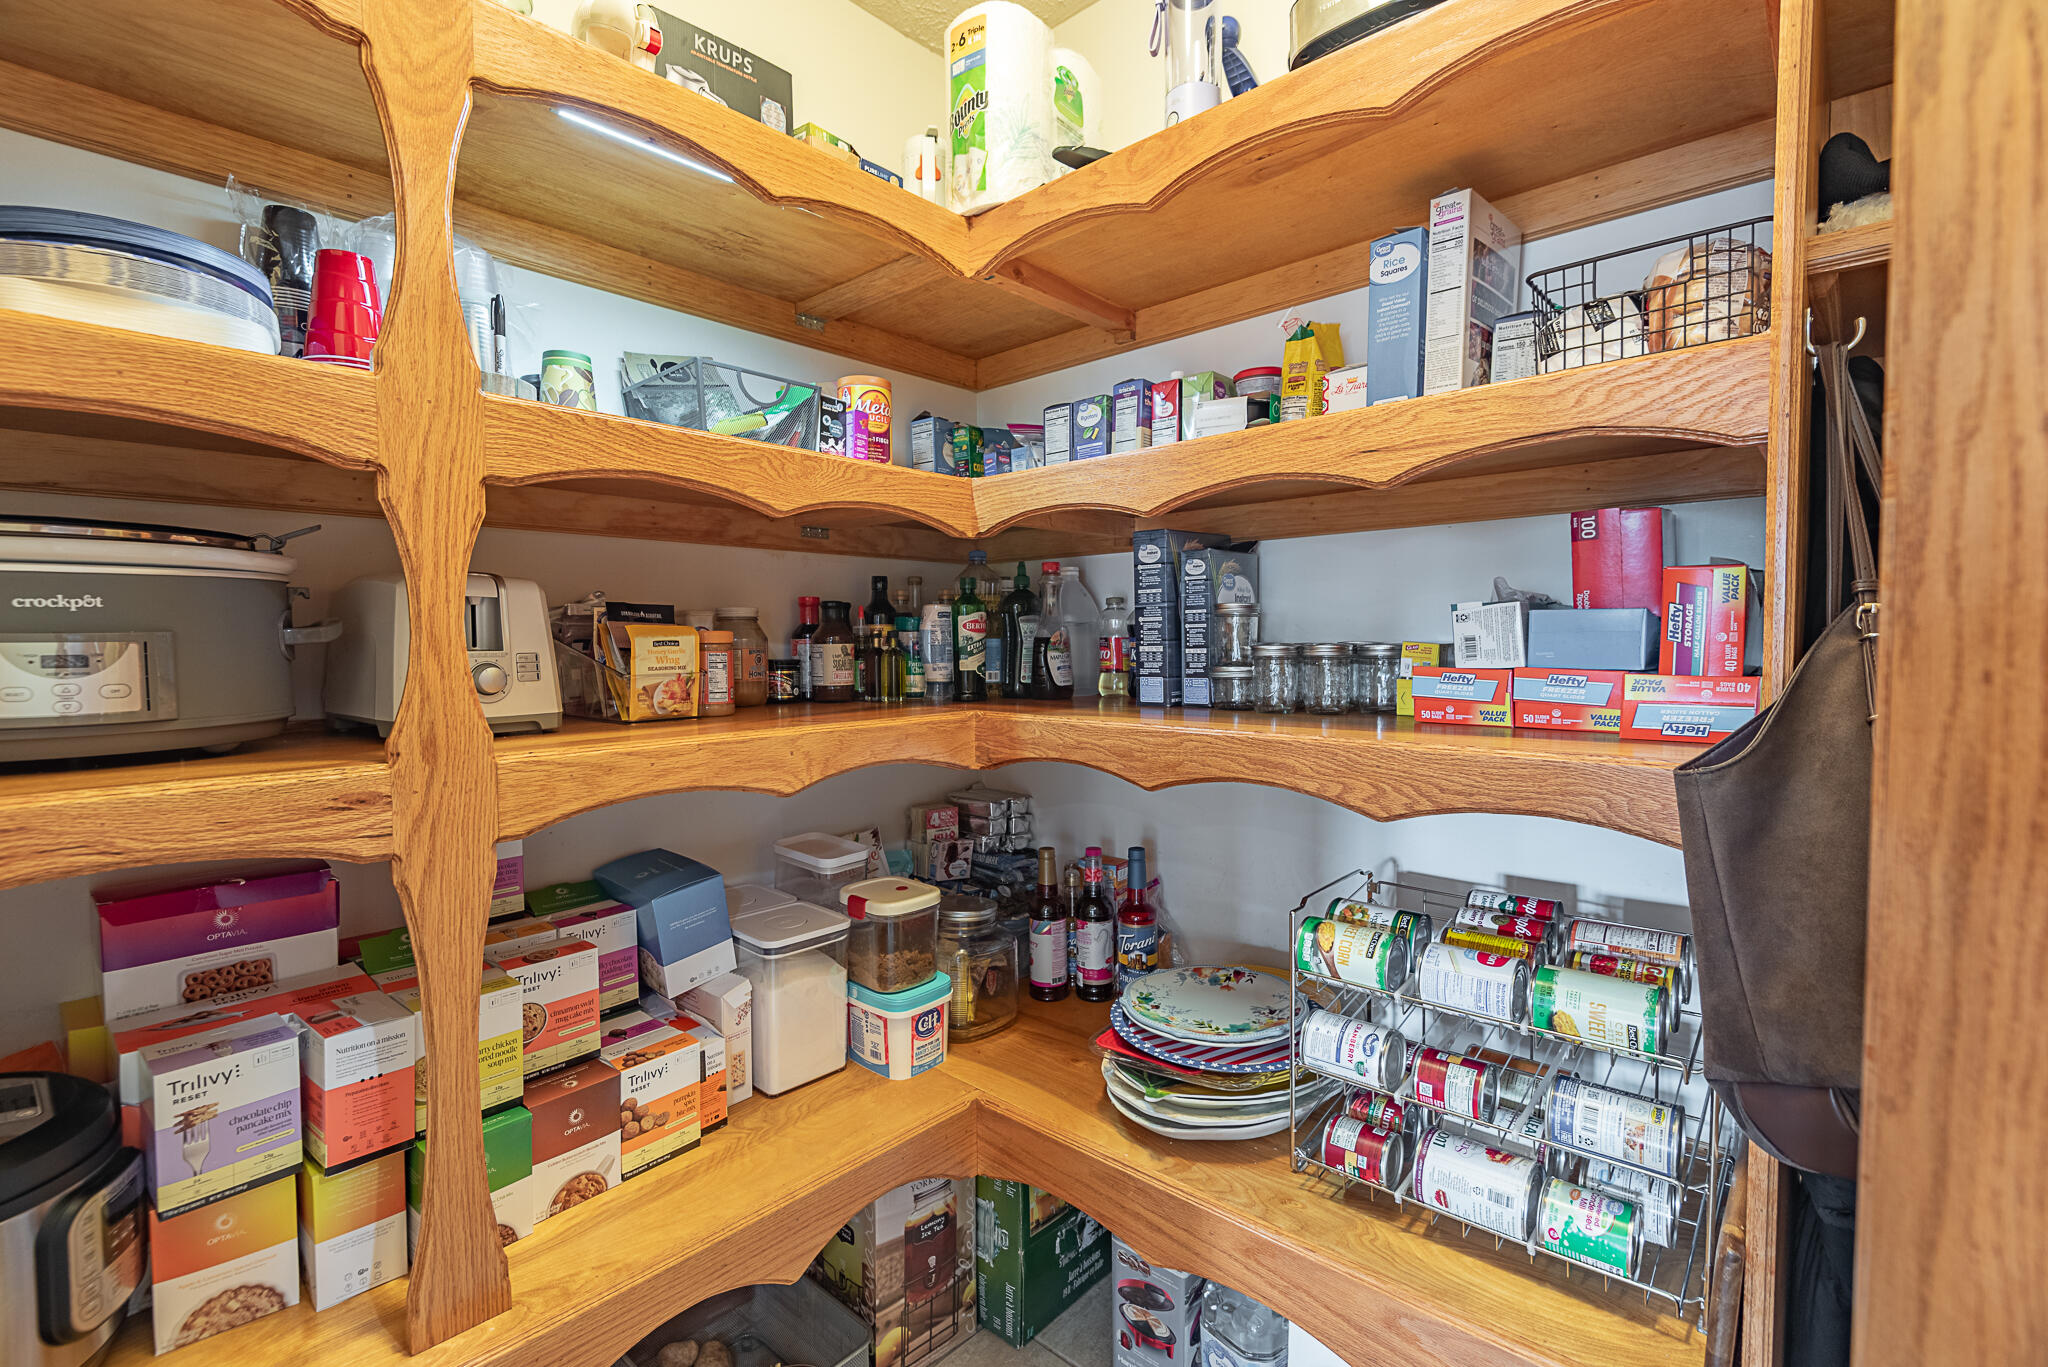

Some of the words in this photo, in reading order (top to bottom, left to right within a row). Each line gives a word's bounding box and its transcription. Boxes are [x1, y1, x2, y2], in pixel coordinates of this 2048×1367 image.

[694, 33, 753, 74] KRUPS
[1383, 256, 1406, 270] Rice
[1380, 265, 1408, 279] Squares
[870, 414, 889, 424] UCIL
[1581, 515, 1596, 539] 100
[1722, 572, 1732, 604] VALUE
[1731, 574, 1740, 601] PACK
[11, 594, 104, 612] crockpot
[1668, 604, 1684, 641] Hefty
[1684, 603, 1694, 648] STORAGE
[655, 655, 680, 665] Wing
[1724, 660, 1738, 672] 40
[1442, 673, 1474, 685] Hefty
[1548, 675, 1585, 688] Hefty
[1541, 686, 1586, 695] FREEZER
[1630, 685, 1667, 693] VALUE
[1736, 682, 1752, 693] 40
[1421, 710, 1431, 718] 50
[1480, 710, 1507, 718] VALUE
[1523, 714, 1534, 723] 50
[1590, 714, 1621, 722] VALUE
[1662, 714, 1716, 724] FREEZER
[1664, 723, 1708, 736] Hefty
[929, 811, 941, 828] 4
[1400, 914, 1411, 929] Best
[206, 928, 246, 942] OPTAVIA
[1119, 931, 1156, 954] Torani
[1337, 940, 1353, 966] CORN
[1367, 940, 1378, 958] Choice
[515, 967, 557, 986] Trilivy
[523, 985, 541, 994] ESET
[549, 1003, 580, 1018] cinnamon
[580, 998, 595, 1009] swirl
[554, 1014, 569, 1025] mug
[569, 1010, 583, 1020] cake
[583, 1007, 595, 1016] mix
[1588, 1001, 1606, 1040] SWEET
[1628, 1026, 1638, 1041] Best
[335, 1041, 366, 1055] Nutrition
[366, 1039, 376, 1048] on
[381, 1032, 406, 1045] mission
[491, 1037, 518, 1051] chicken
[1347, 1023, 1363, 1065] CRANBERRY
[494, 1045, 518, 1059] noodle
[487, 1059, 504, 1069] soup
[504, 1054, 518, 1064] mix
[166, 1067, 234, 1096] Trilivy
[628, 1064, 665, 1087] Trilivy
[630, 1082, 651, 1093] RESET
[172, 1091, 208, 1105] RESET
[673, 1090, 696, 1106] pumpkin
[228, 1107, 274, 1126] chocolate
[273, 1099, 293, 1112] chip
[235, 1115, 275, 1136] pancake
[275, 1110, 293, 1121] mix
[564, 1123, 591, 1136] OPTAVIA
[919, 1216, 946, 1231] Lemony
[920, 1230, 932, 1239] Ice
[933, 1223, 945, 1233] Tea
[206, 1230, 248, 1246] OPTAVIA
[1005, 1281, 1016, 1300] Jarre
